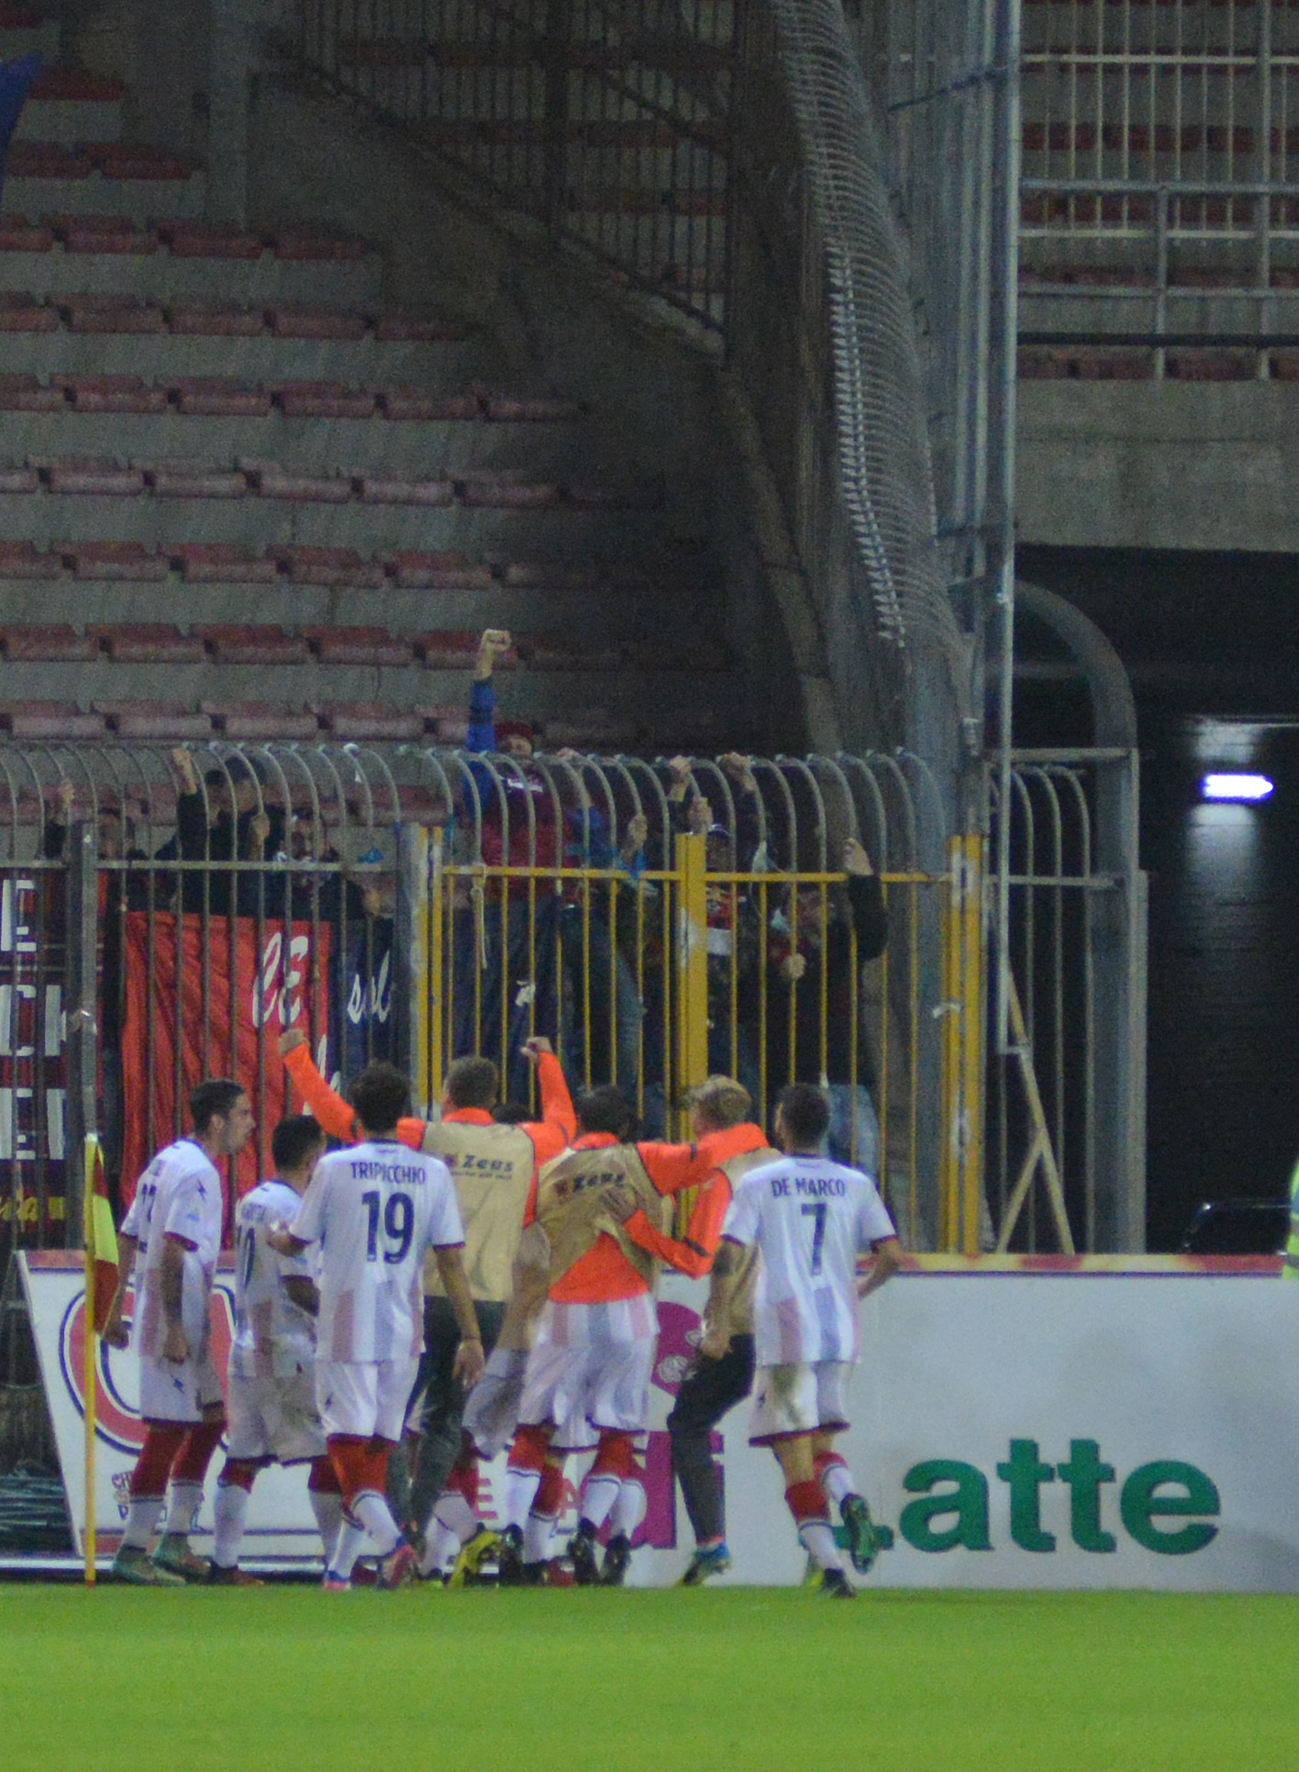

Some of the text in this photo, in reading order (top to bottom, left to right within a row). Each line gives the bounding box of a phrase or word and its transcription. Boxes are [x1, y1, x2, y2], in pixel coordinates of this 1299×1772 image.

[771, 1177, 846, 1198] DE MARCO
[361, 1190, 415, 1265] 19
[801, 1202, 828, 1277] 7
[830, 1438, 1222, 1554] atte
